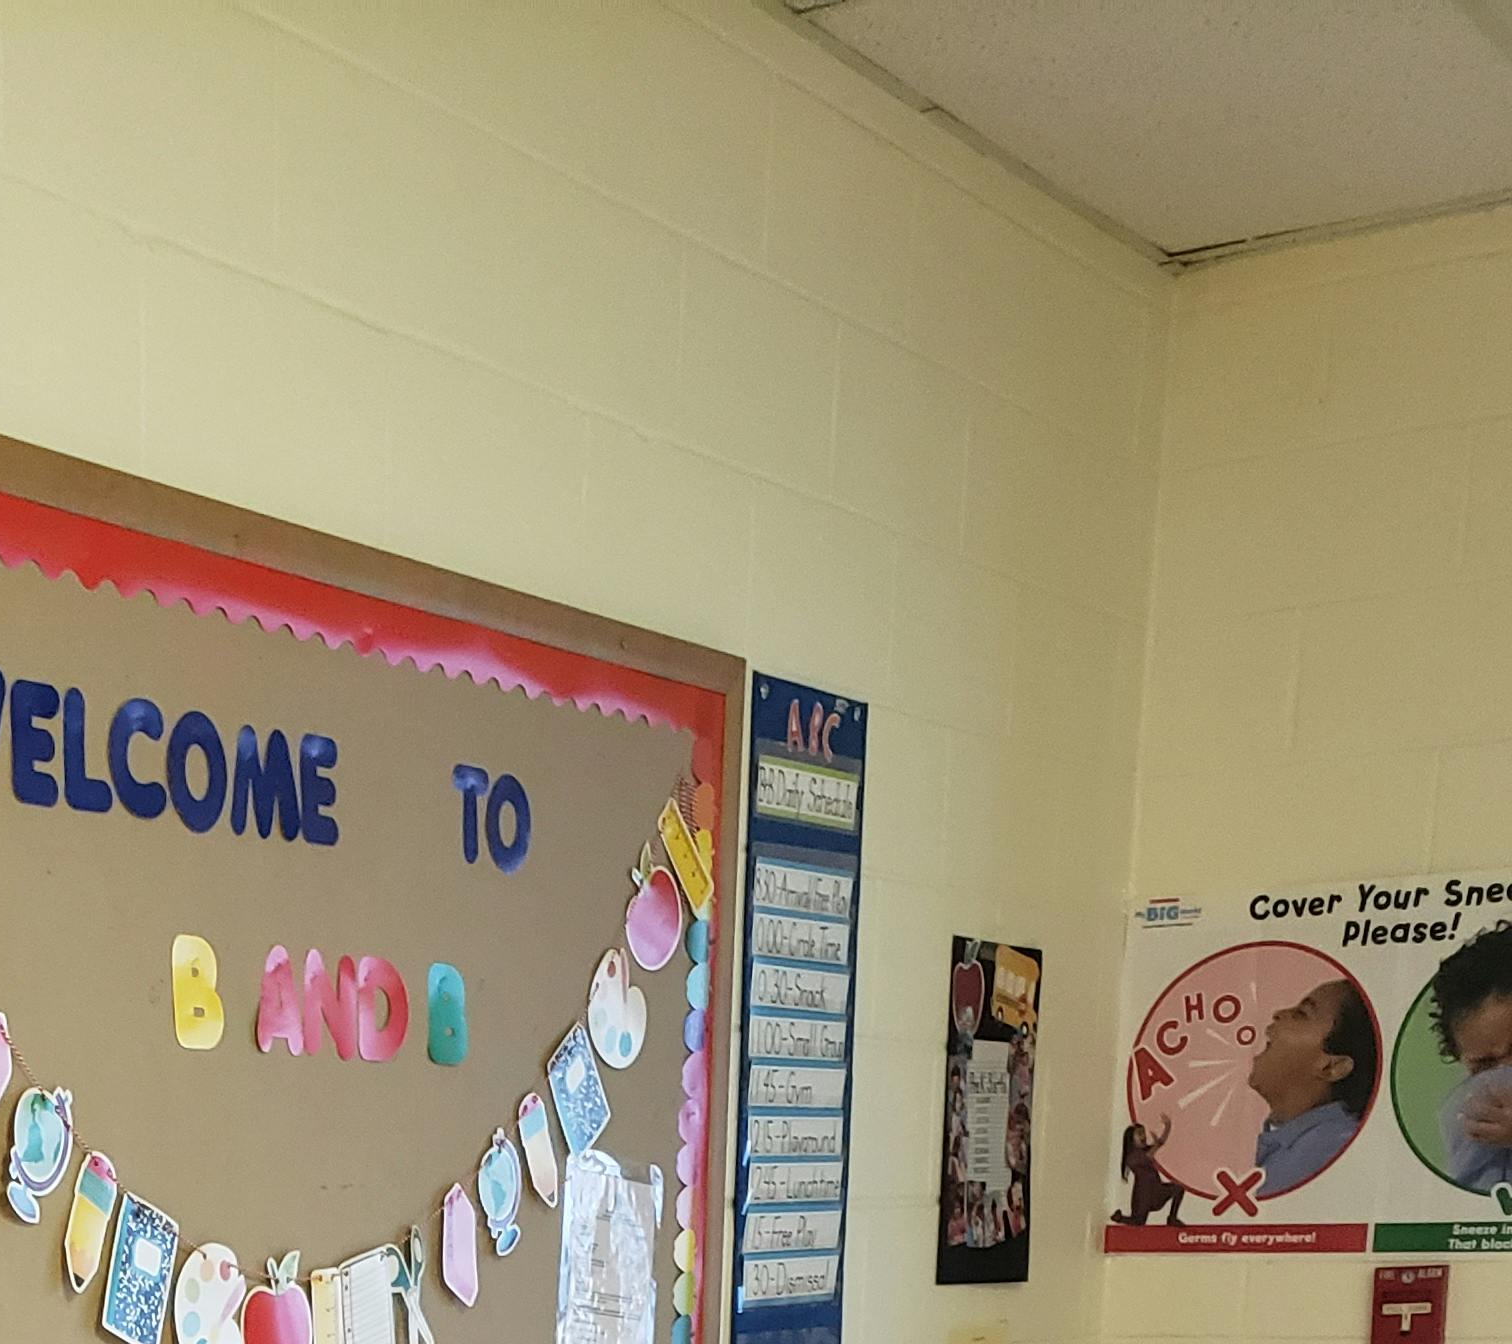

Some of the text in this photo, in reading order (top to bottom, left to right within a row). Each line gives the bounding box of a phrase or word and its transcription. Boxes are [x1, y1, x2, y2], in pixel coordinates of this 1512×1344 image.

[452, 763, 532, 875] TO
[1249, 893, 1342, 921] Cover
[1358, 884, 1430, 913] Your
[1343, 912, 1462, 947] Please!
[170, 933, 468, 1066] B AND B
[1178, 1232, 1218, 1245] Germs
[1221, 1231, 1238, 1246] fly
[1481, 1238, 1512, 1251] bloc
